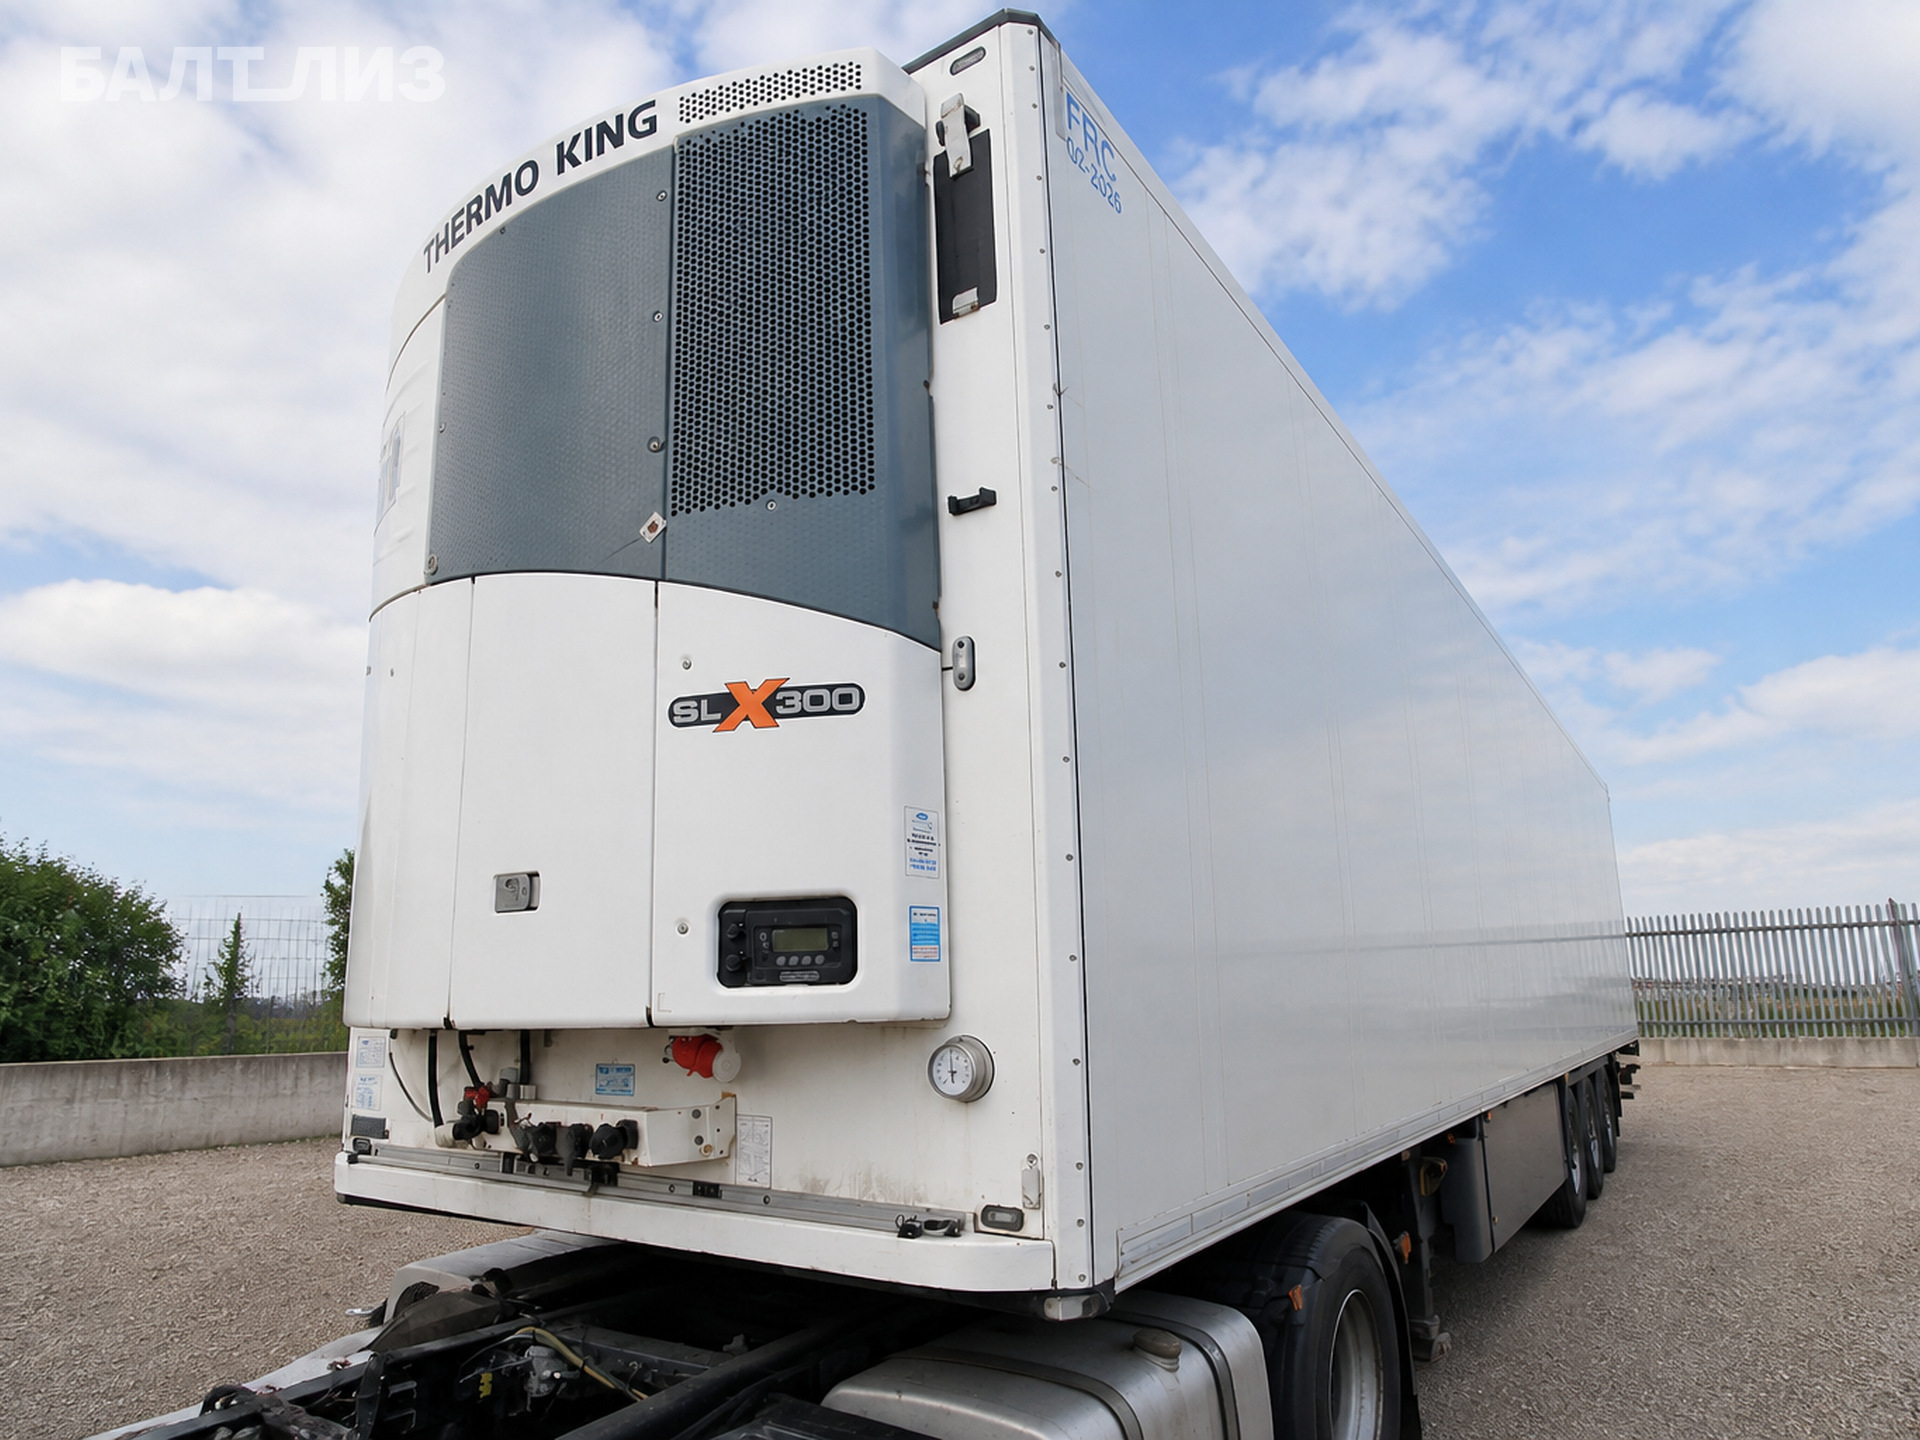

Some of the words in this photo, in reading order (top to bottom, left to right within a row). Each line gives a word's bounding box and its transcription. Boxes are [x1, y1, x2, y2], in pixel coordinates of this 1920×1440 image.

[1066, 91, 1117, 182] FRC
[423, 159, 539, 273] THERMO
[556, 99, 657, 176] KING
[673, 677, 860, 733] SLX300
